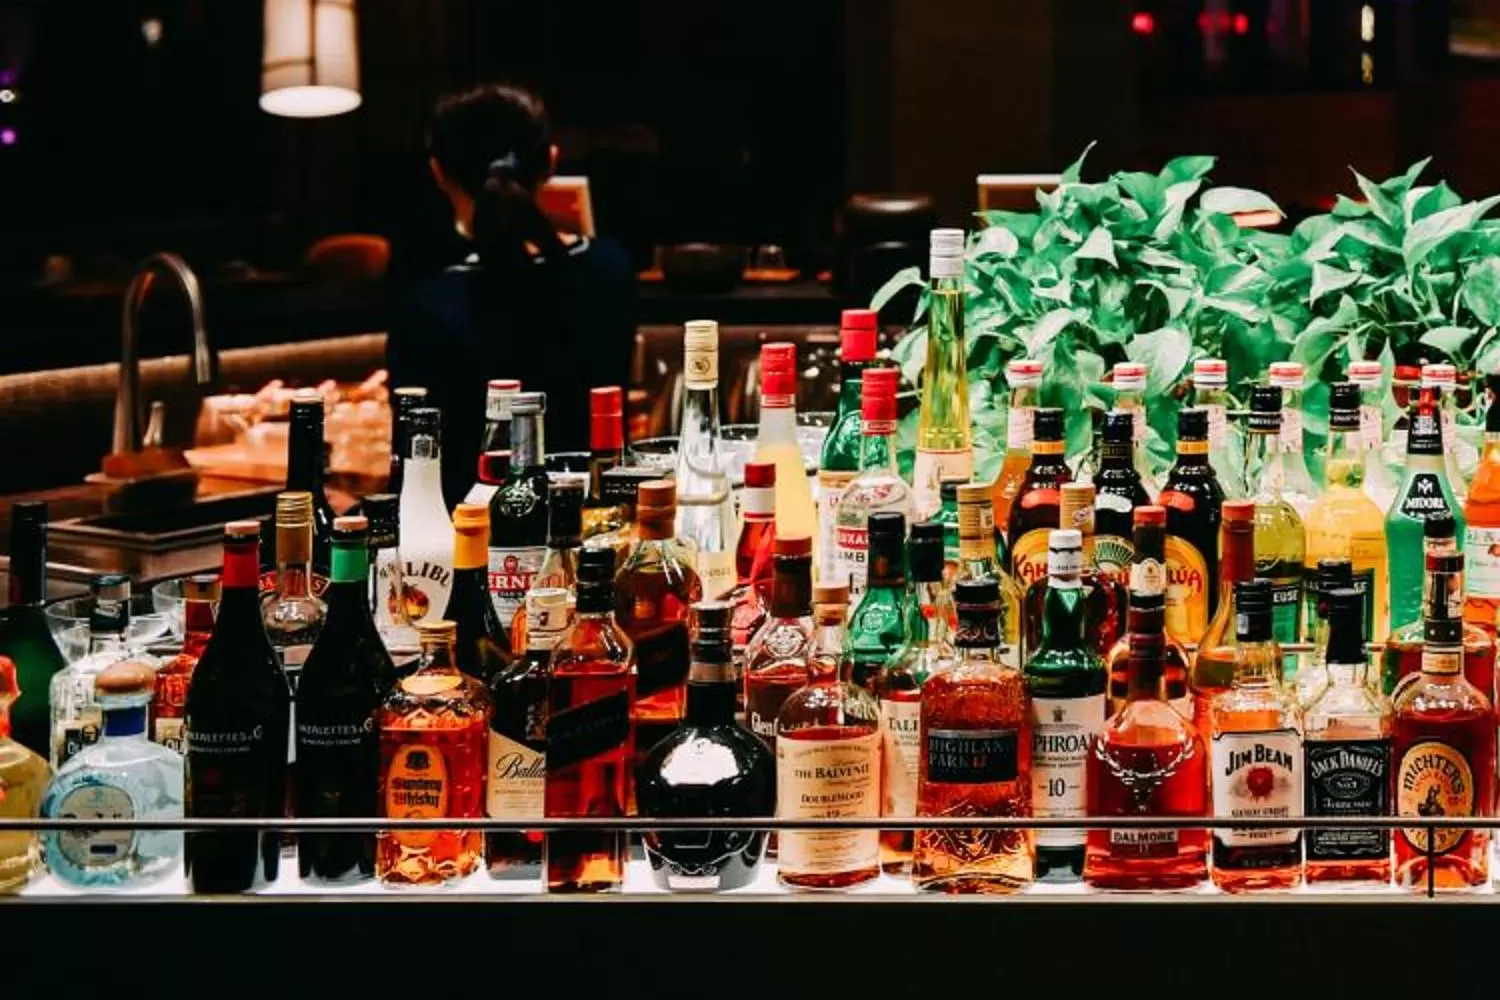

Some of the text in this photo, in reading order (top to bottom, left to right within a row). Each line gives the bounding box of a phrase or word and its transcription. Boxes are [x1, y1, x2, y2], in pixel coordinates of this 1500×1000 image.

[1226, 744, 1293, 776] JIM BEAM
[1311, 754, 1340, 779] JACK
[1048, 778, 1065, 797] 10
